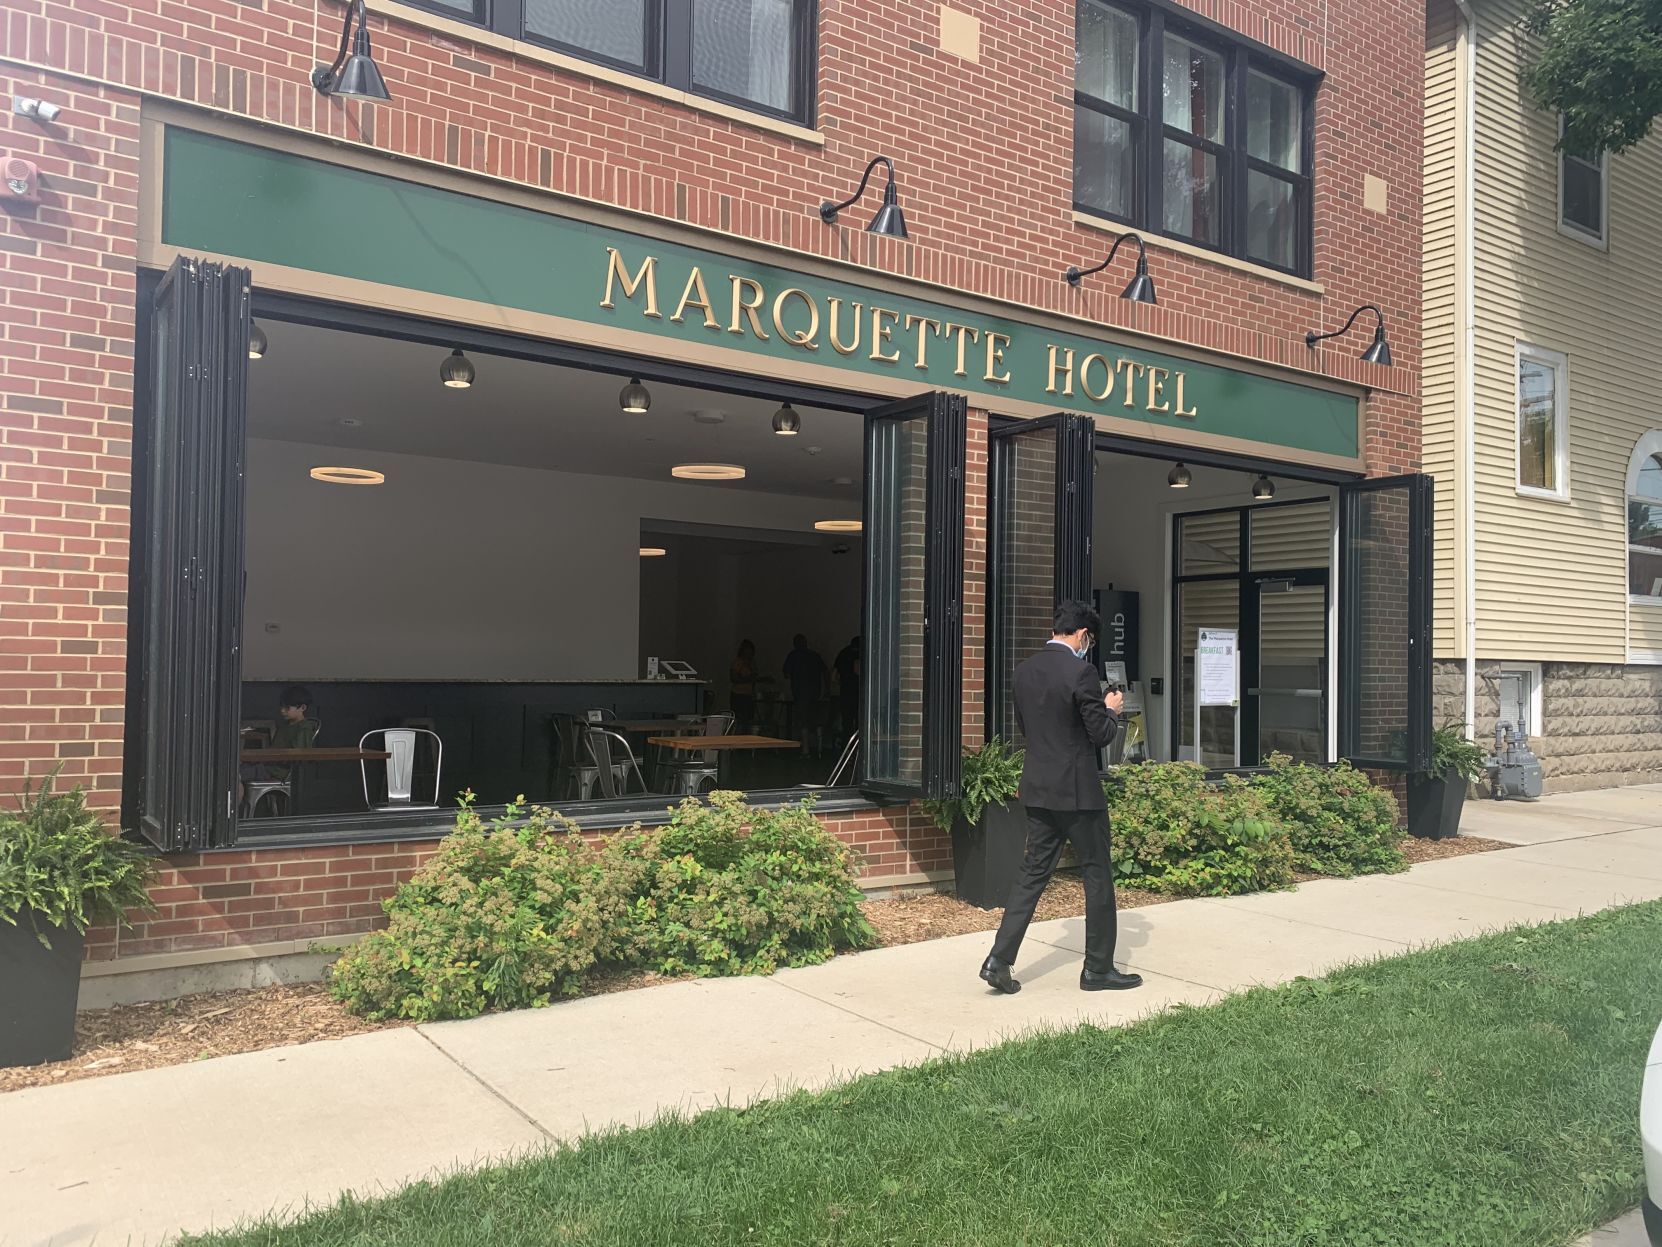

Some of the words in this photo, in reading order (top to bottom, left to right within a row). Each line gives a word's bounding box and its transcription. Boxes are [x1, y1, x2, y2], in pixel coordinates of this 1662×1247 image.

[600, 247, 1011, 384] MARQUETTE
[1045, 344, 1197, 416] HOTEL
[1110, 612, 1125, 655] hub
